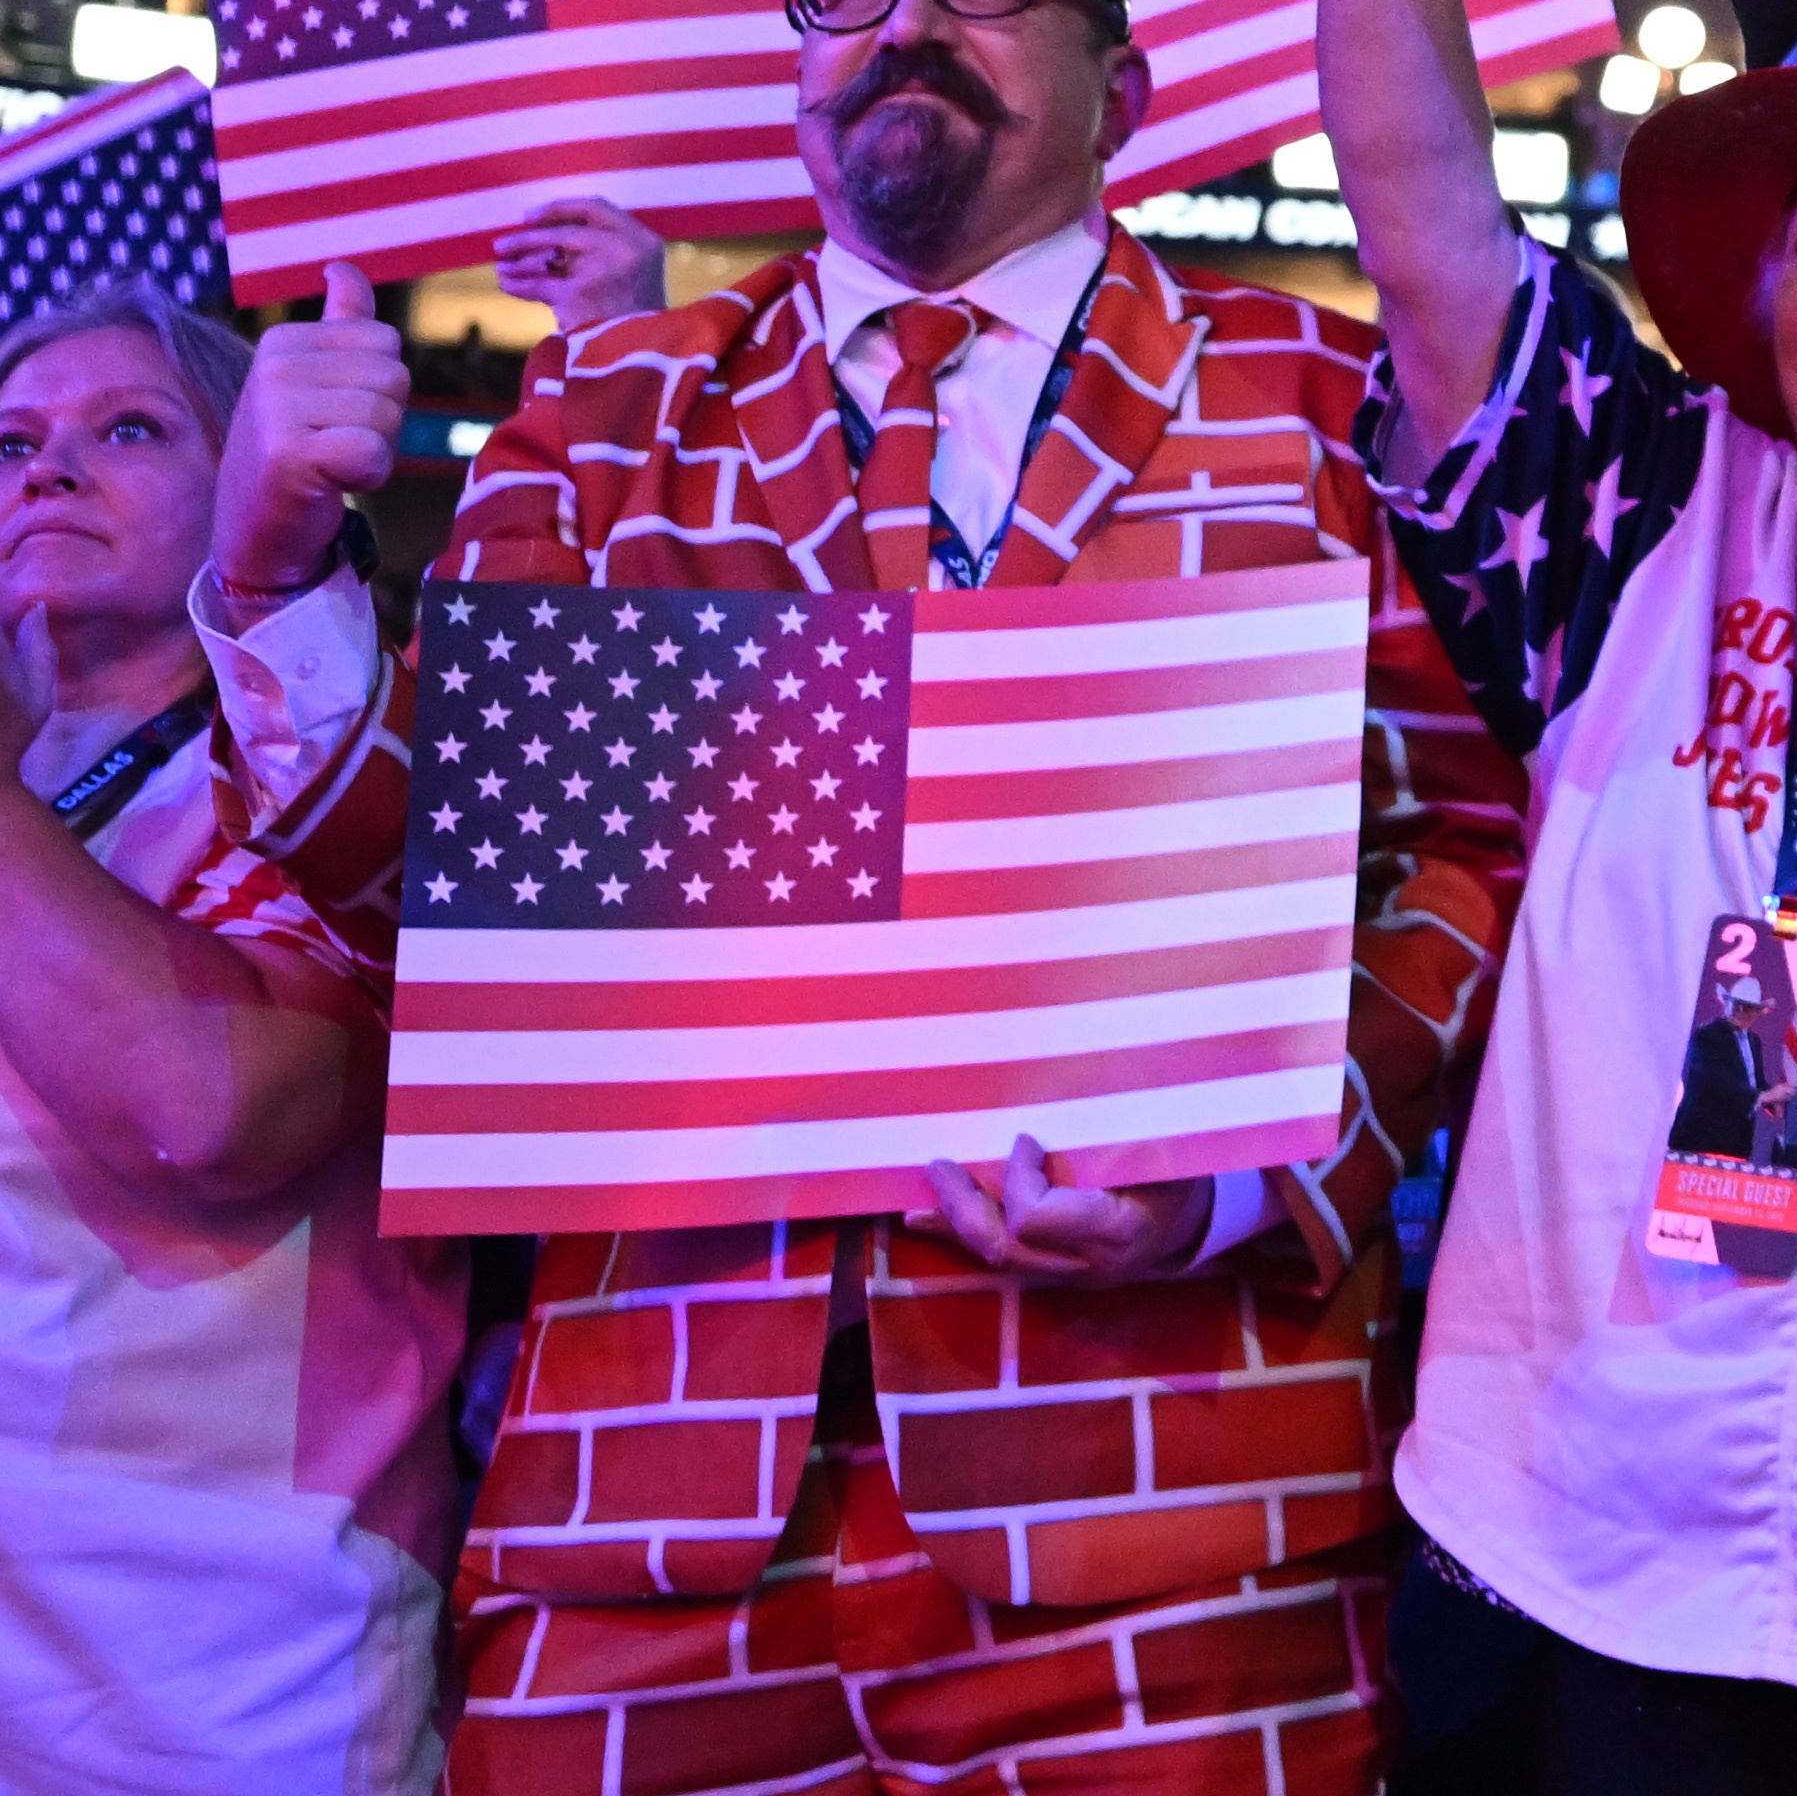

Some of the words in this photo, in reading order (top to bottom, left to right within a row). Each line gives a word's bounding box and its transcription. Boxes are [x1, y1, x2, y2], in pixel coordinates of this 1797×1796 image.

[55, 750, 136, 811] DALLAS
[1715, 922, 1758, 976] 2
[1677, 1169, 1739, 1201] SPECIAL
[1743, 1180, 1793, 1208] GUEST
